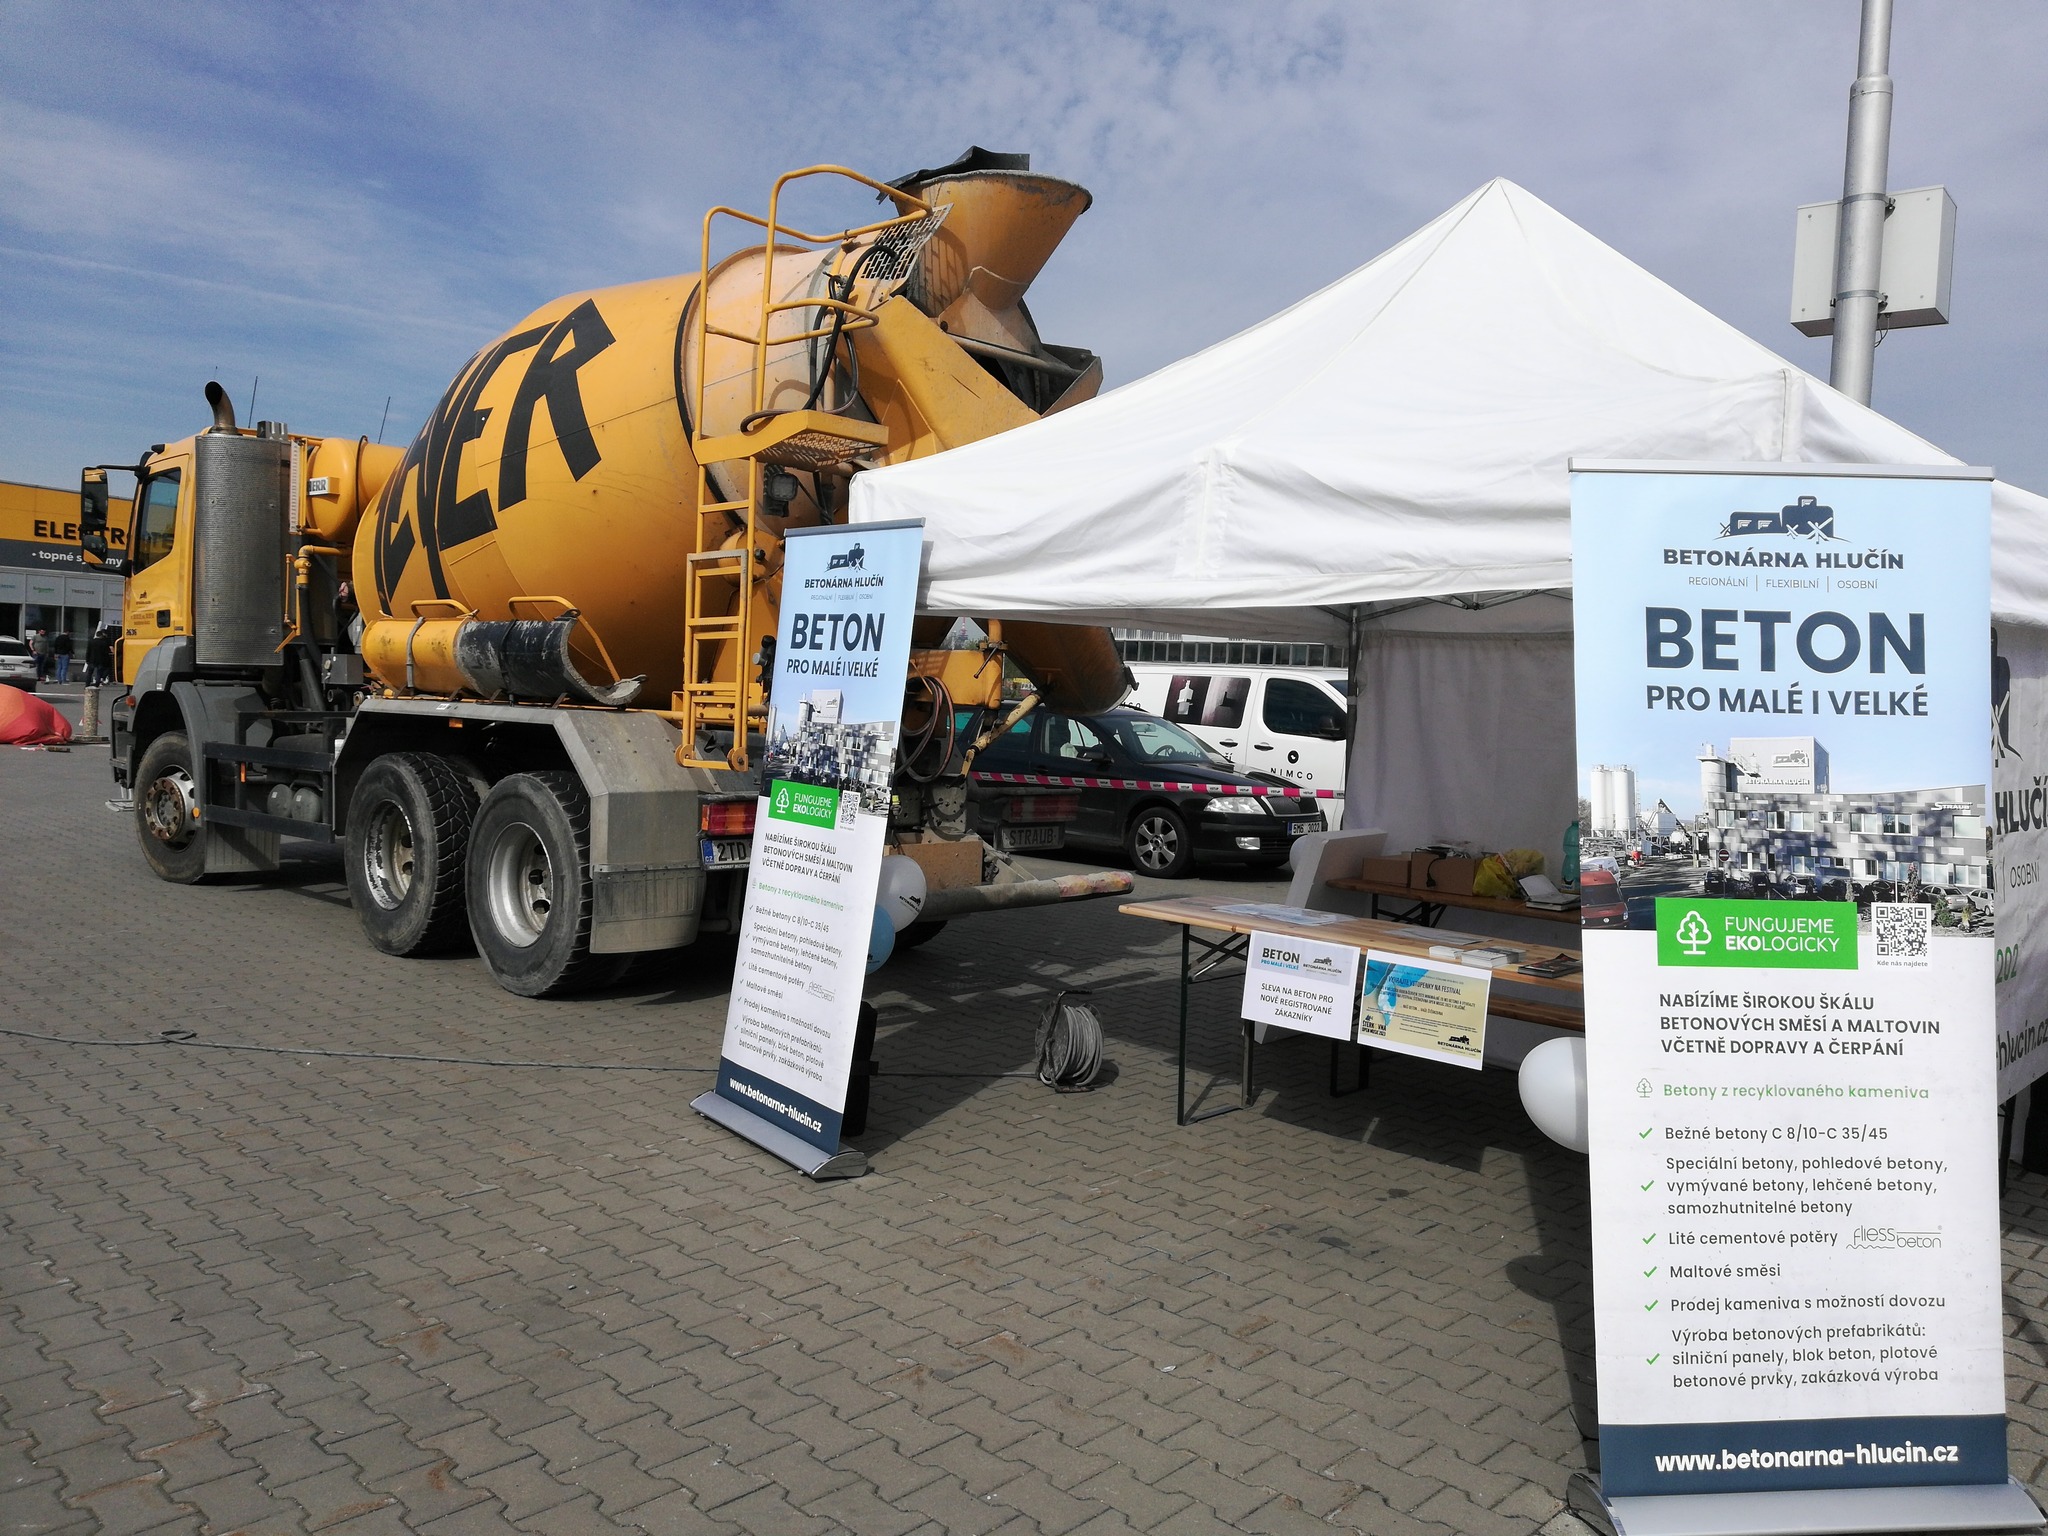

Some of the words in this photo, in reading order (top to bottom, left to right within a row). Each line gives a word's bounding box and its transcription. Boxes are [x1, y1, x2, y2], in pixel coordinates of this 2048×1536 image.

[40, 551, 74, 562] topné
[1664, 547, 1809, 568] BETONÁRNA
[1816, 548, 1904, 570] HLUČÍN
[805, 576, 852, 588] BETONÁRNA
[855, 574, 883, 587] HLUČÍN
[1688, 576, 1748, 587] REGIONÁLNÍ
[1766, 578, 1819, 589] FLEXIBILNÍ
[1837, 579, 1878, 590] OSOBNÍ
[790, 613, 885, 651] BETON
[1645, 606, 1926, 674] BETON
[787, 658, 809, 674] PRO
[812, 657, 842, 676] MALÉ
[842, 662, 846, 676] I
[848, 657, 879, 677] VELKÉ
[1647, 686, 1710, 711] PRO
[1719, 681, 1803, 715] MALÉ
[1813, 691, 1819, 714] I
[1828, 684, 1928, 716] VELKÉ
[1271, 768, 1313, 780] NIMCO
[794, 792, 832, 808] FUNGUJEME
[1995, 776, 2048, 835] HLUČÍ
[793, 804, 833, 819] EKOLOGICKY
[1308, 823, 1320, 832] 3022
[765, 832, 793, 845] NABÍZÍME
[794, 837, 820, 851] ŠIROKOU
[820, 843, 837, 855] ŠKÁLU
[1009, 828, 1054, 847] STRAUB
[763, 845, 803, 861] BETONOVÝCH
[805, 853, 822, 864] SMĚSÍ
[826, 859, 853, 873] MALTOVIN
[762, 858, 784, 870] VČETNĚ
[785, 863, 814, 878] DOPRAVY
[819, 869, 841, 884] ČERPÁNÍ
[2010, 861, 2040, 888] OSOBNÍ
[759, 882, 777, 894] Betony
[772, 910, 791, 923] betony
[1725, 916, 1834, 934] FUNGUJEME
[1725, 935, 1840, 953] EKOLOGICKY
[1262, 948, 1300, 963] BETON
[1903, 960, 1928, 968] najdete
[758, 966, 787, 981] cementové
[1261, 983, 1280, 993] SLEVA
[1282, 987, 1292, 996] NA
[1294, 989, 1317, 1000] BETON
[1318, 994, 1333, 1003] PRO
[1442, 985, 1461, 995] FESTIVAL
[744, 998, 760, 1012] Prodej
[761, 1004, 786, 1020] kameniva
[1260, 994, 1279, 1004] NOVÉ
[1280, 998, 1332, 1015] REGISTROVANÉ
[1660, 991, 1739, 1008] NABÍZÍME
[1743, 991, 1814, 1009] ŠIROKOU
[1820, 993, 1874, 1011] ŠKÁLU
[1660, 1013, 1775, 1031] BETONOVÝCH
[1779, 1014, 1827, 1032] SMĚSÍ
[1832, 1019, 1843, 1032] A
[1848, 1019, 1940, 1034] MALTOVIN
[1661, 1036, 1725, 1054] VČETNĚ
[1730, 1041, 1809, 1055] DOPRAVY
[1814, 1042, 1824, 1054] A
[1829, 1038, 1903, 1056] ČERPÁNÍ
[1664, 1084, 1717, 1100] Betony
[1721, 1087, 1729, 1097] z
[1733, 1083, 1844, 1101] recyklovaného
[1849, 1084, 1928, 1099] kameniva
[730, 1078, 822, 1133] www.betonarna-hlucin.cz
[1716, 1127, 1767, 1143] betony
[1772, 1128, 1782, 1139] C
[1842, 1124, 1888, 1142] 35/45
[1666, 1157, 1737, 1173] Speciální
[1742, 1157, 1798, 1174] betony,
[1802, 1157, 1882, 1173] pohledové
[1887, 1158, 1948, 1174] betony,
[1667, 1179, 1748, 1196] vymývané
[1753, 1180, 1809, 1196] betony,
[1813, 1178, 1872, 1192] lehčené
[1877, 1179, 1937, 1195] betony,
[1668, 1201, 1796, 1215] samozhutnitelné
[1801, 1201, 1852, 1217] betony
[1669, 1231, 1695, 1244] Lité
[1700, 1231, 1785, 1245] cementové
[1790, 1230, 1838, 1247] potěry
[1896, 1233, 1942, 1248] beton
[1670, 1264, 1732, 1278] Maltové
[1737, 1263, 1781, 1277] směsi
[1671, 1298, 1720, 1315] Prodej
[1725, 1296, 1800, 1311] kameniva
[1804, 1299, 1812, 1310] s
[1816, 1294, 1885, 1309] možností
[1889, 1294, 1945, 1309] dovozu
[1672, 1328, 1728, 1345] Výroba
[1733, 1325, 1822, 1343] betonových
[1827, 1322, 1926, 1341] prefabrikátů:
[1672, 1350, 1727, 1365] silniční
[1733, 1350, 1788, 1367] panely,
[1793, 1348, 1823, 1362] blok
[1828, 1347, 1875, 1363] beton,
[1880, 1346, 1937, 1363] plotové
[1673, 1371, 1746, 1388] betonové
[1751, 1370, 1797, 1389] prvky,
[1802, 1368, 1880, 1384] zakázková
[1885, 1368, 1938, 1384] výroba
[1655, 1440, 1959, 1472] www.betonarna-hlucin.cz
